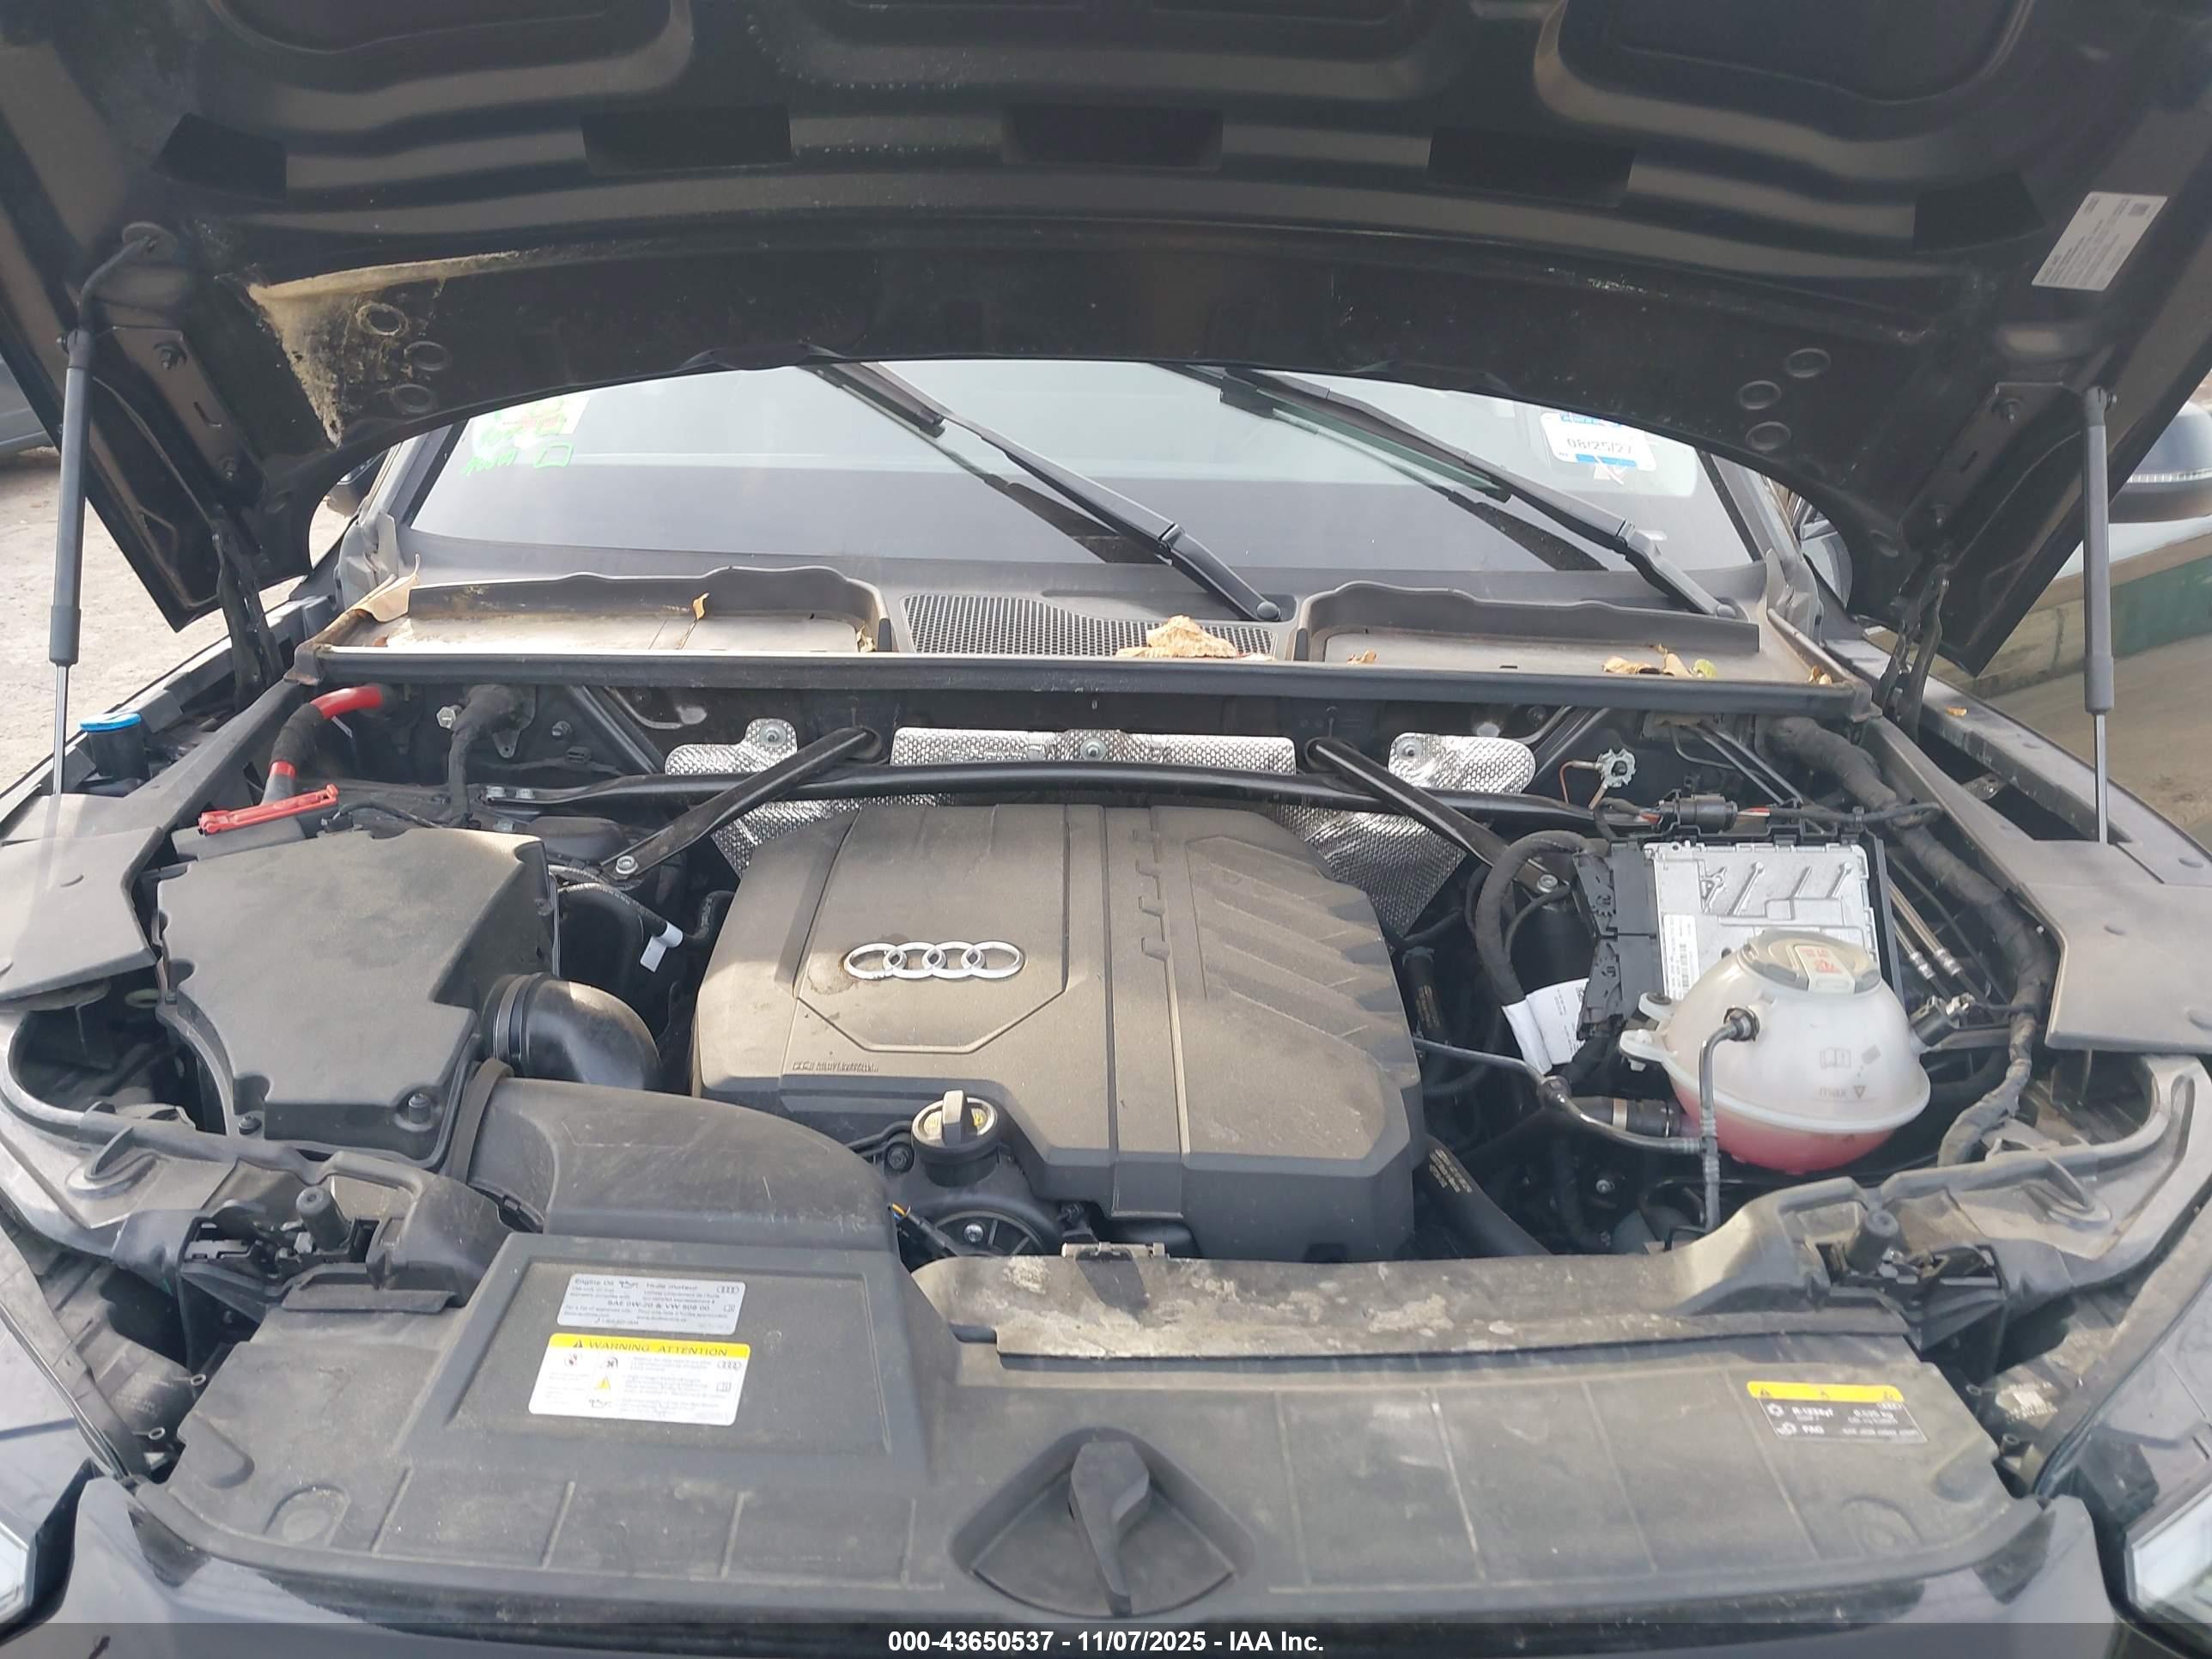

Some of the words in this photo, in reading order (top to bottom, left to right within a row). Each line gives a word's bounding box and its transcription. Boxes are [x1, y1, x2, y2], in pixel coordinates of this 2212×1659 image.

[1819, 1086, 1848, 1098] max
[588, 1340, 650, 1352] WARNING
[657, 1345, 729, 1357] ATTENTION
